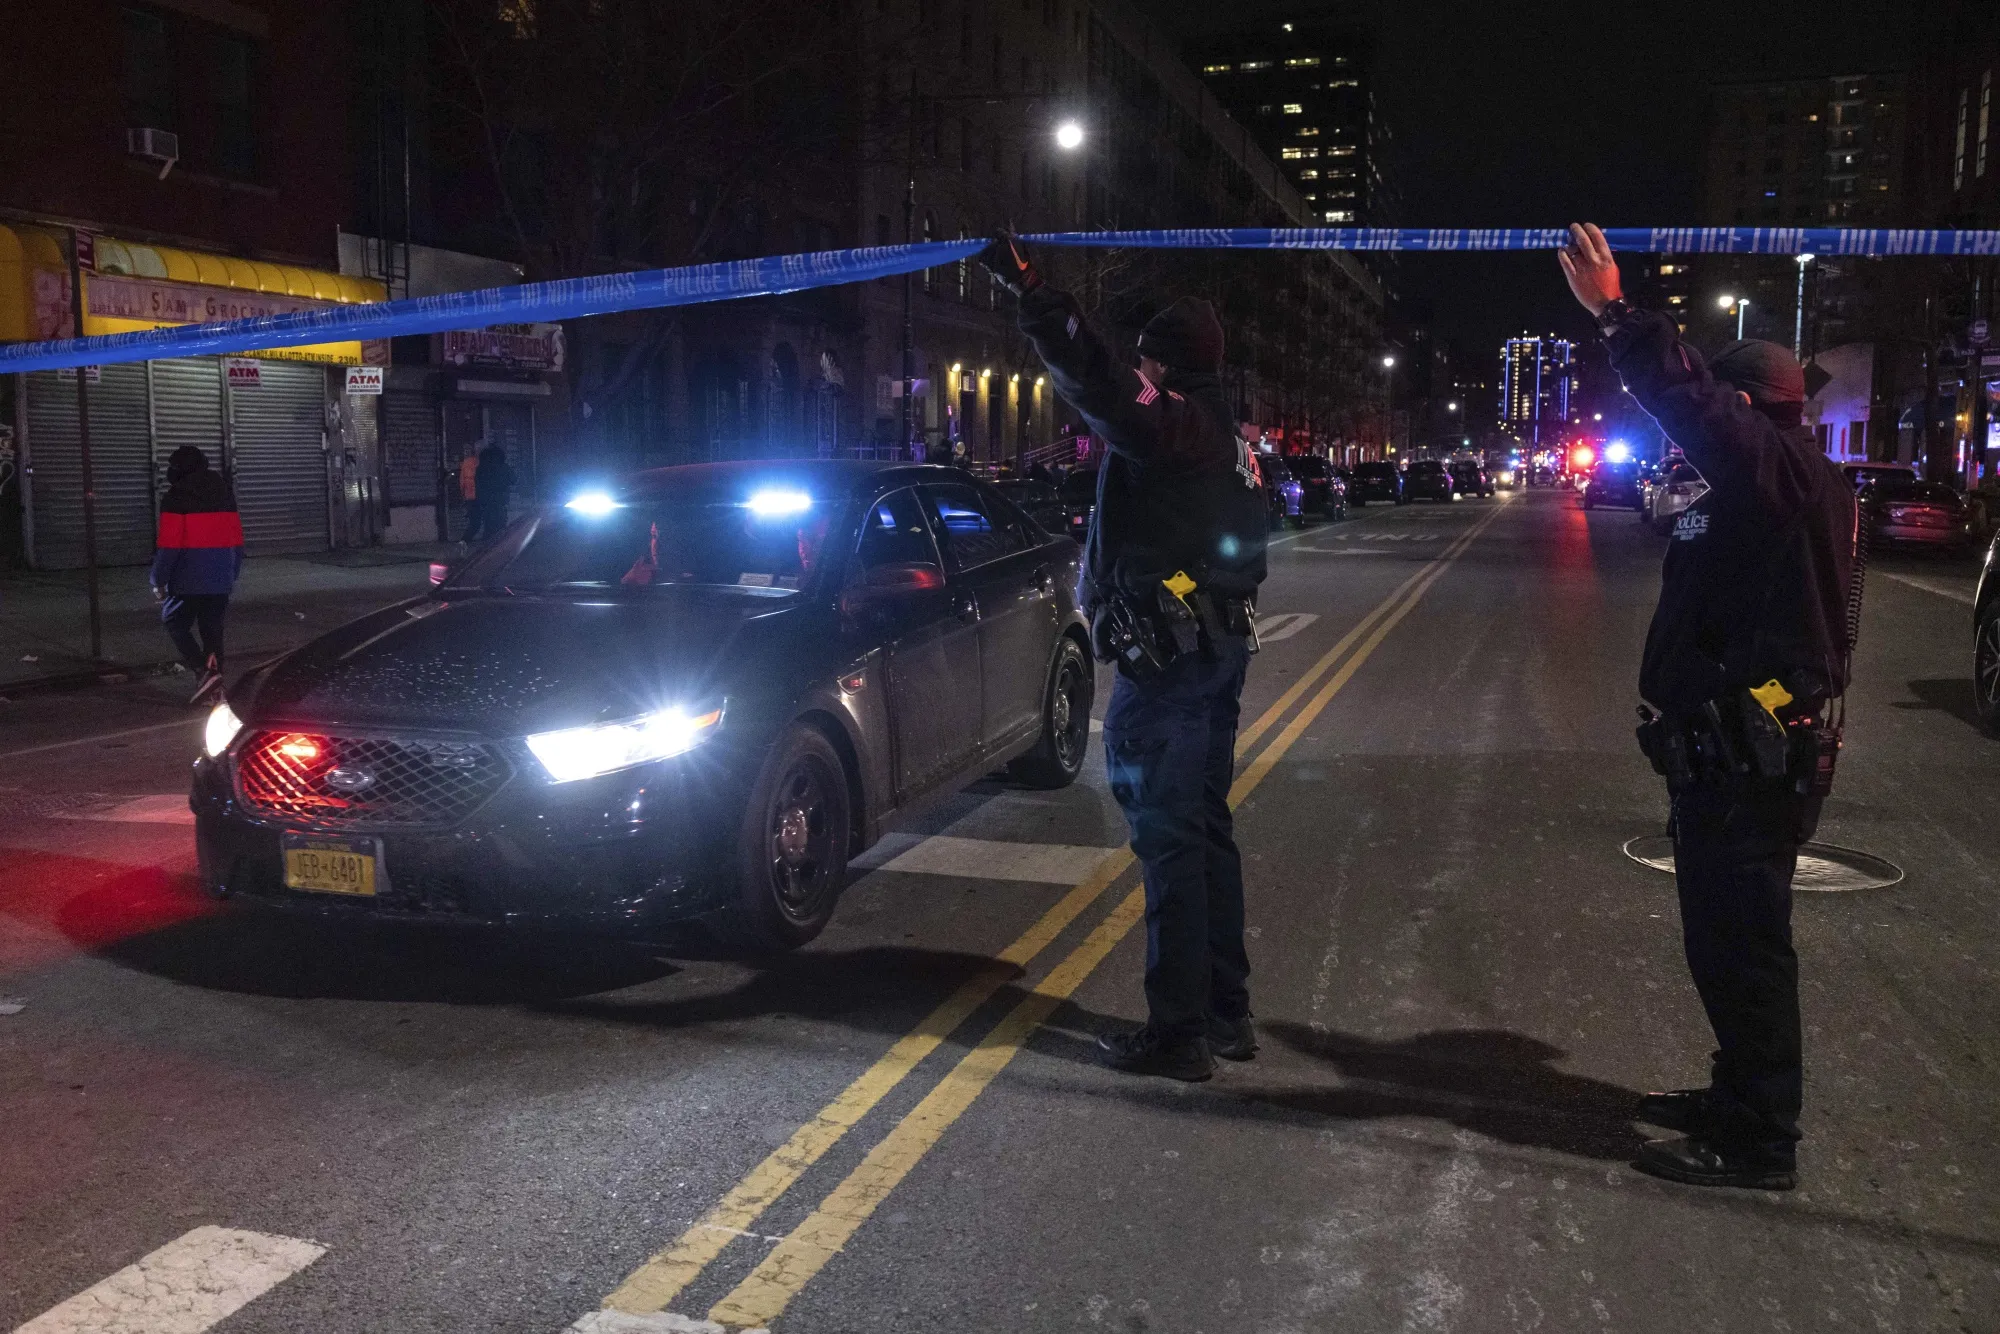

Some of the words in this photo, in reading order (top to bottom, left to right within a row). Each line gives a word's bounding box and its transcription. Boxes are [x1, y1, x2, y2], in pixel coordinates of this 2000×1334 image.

[1267, 228, 1347, 250] POLICE
[1354, 228, 1404, 251] LINE
[1427, 229, 1461, 251] DO
[1467, 229, 1512, 251] NOT
[1886, 229, 1940, 255] NOT
[664, 261, 723, 296] POLICE
[727, 257, 768, 289] LINE
[780, 254, 805, 283] DO
[809, 250, 846, 276] NOT
[228, 367, 260, 378] ATM
[348, 375, 381, 384] ATM
